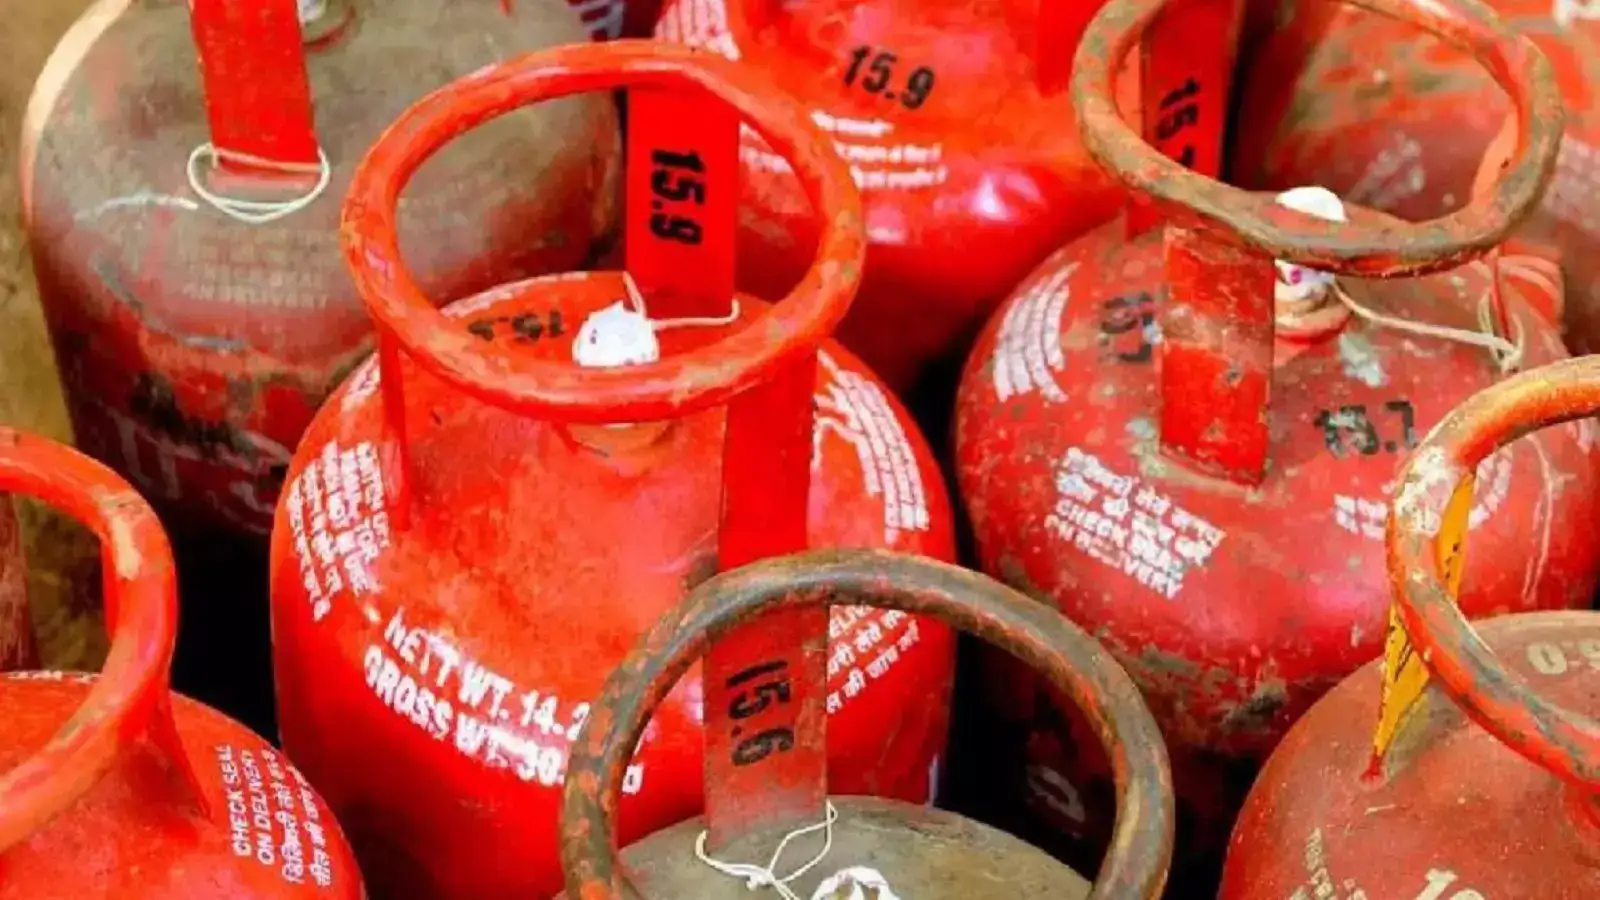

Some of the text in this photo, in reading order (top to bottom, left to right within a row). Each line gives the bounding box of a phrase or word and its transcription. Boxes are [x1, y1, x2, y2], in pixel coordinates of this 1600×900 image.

[844, 45, 936, 110] 15.9
[649, 149, 706, 246] 15.9
[384, 606, 461, 688] NETT
[363, 644, 454, 740] GROSS
[724, 660, 796, 768] 15.6
[226, 786, 253, 857] CHECK
[256, 831, 276, 866] ON
